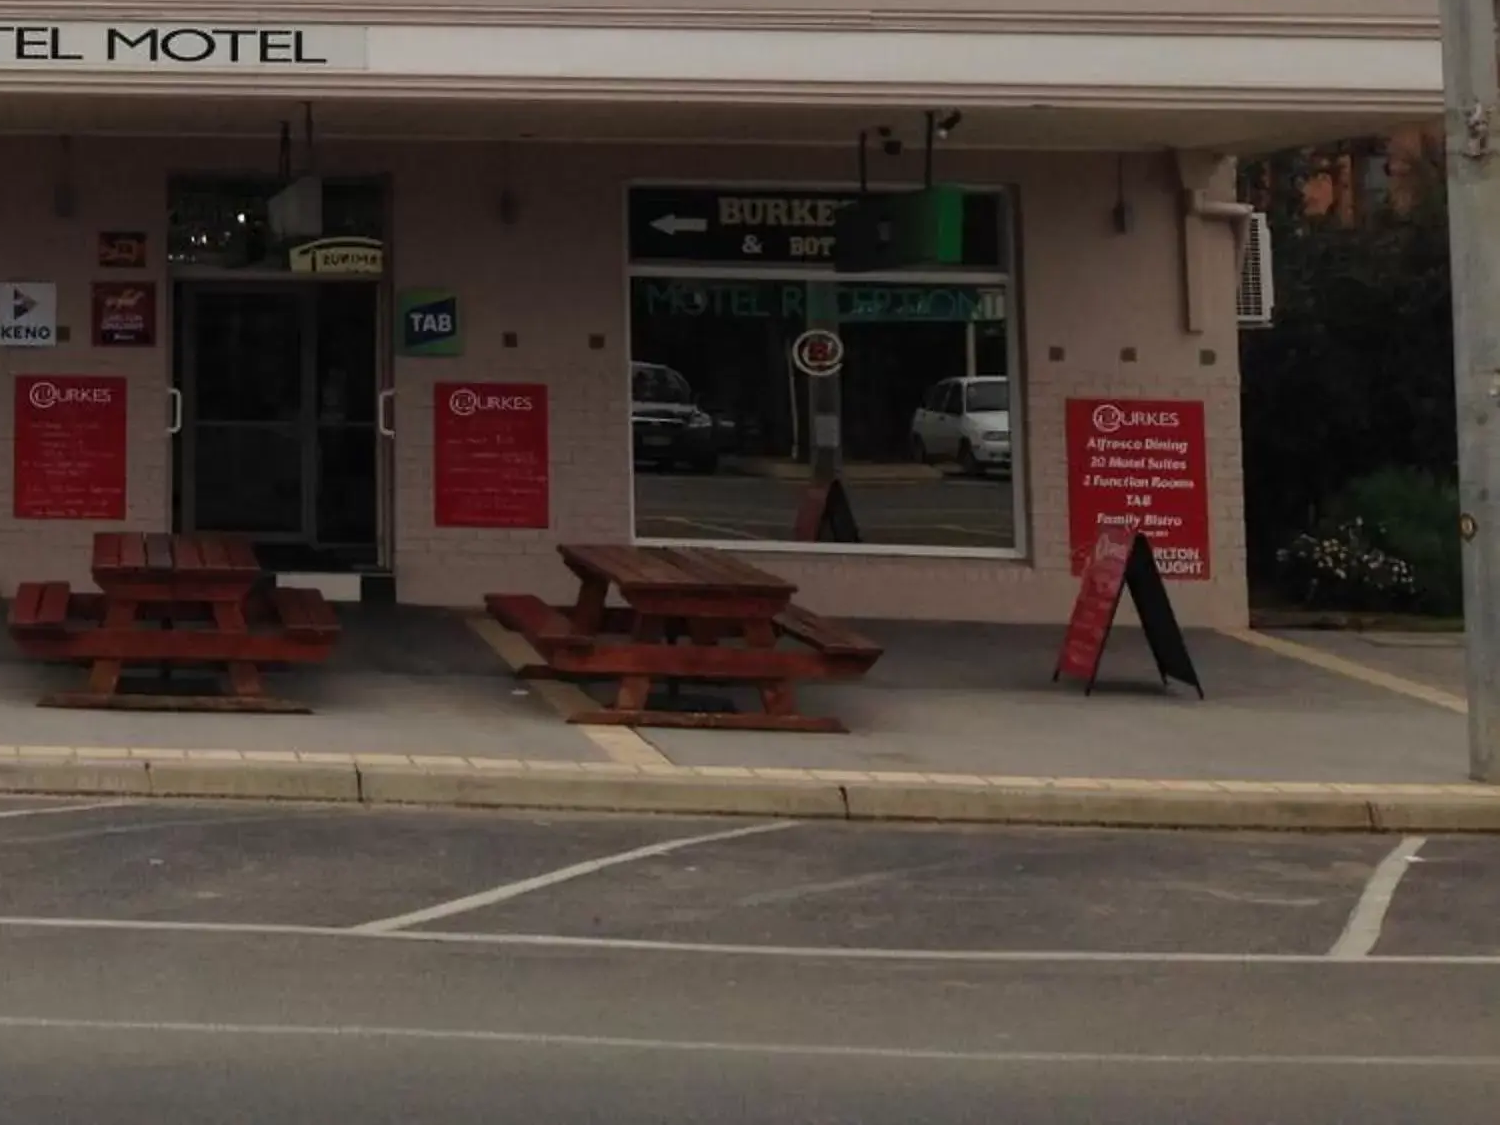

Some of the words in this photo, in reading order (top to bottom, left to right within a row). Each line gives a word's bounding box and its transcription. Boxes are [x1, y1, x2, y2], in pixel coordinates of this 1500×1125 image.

[105, 26, 329, 65] MOTEL
[717, 196, 858, 227] BURKE
[741, 235, 763, 255] &
[789, 236, 835, 257] BOT
[645, 282, 771, 318] MOTEL
[409, 312, 453, 333] TAB
[0, 325, 52, 340] KENO
[1086, 436, 1143, 452] Alfresco
[1145, 438, 1189, 455] Dining
[1108, 456, 1145, 469] Motel
[1147, 457, 1188, 471] Suites
[1093, 475, 1149, 489] Function
[1151, 476, 1195, 490] Rooms
[1126, 493, 1153, 507] TAB
[1096, 512, 1141, 528] Family
[1143, 513, 1183, 527] Bistro
[1153, 546, 1200, 561] RLTON
